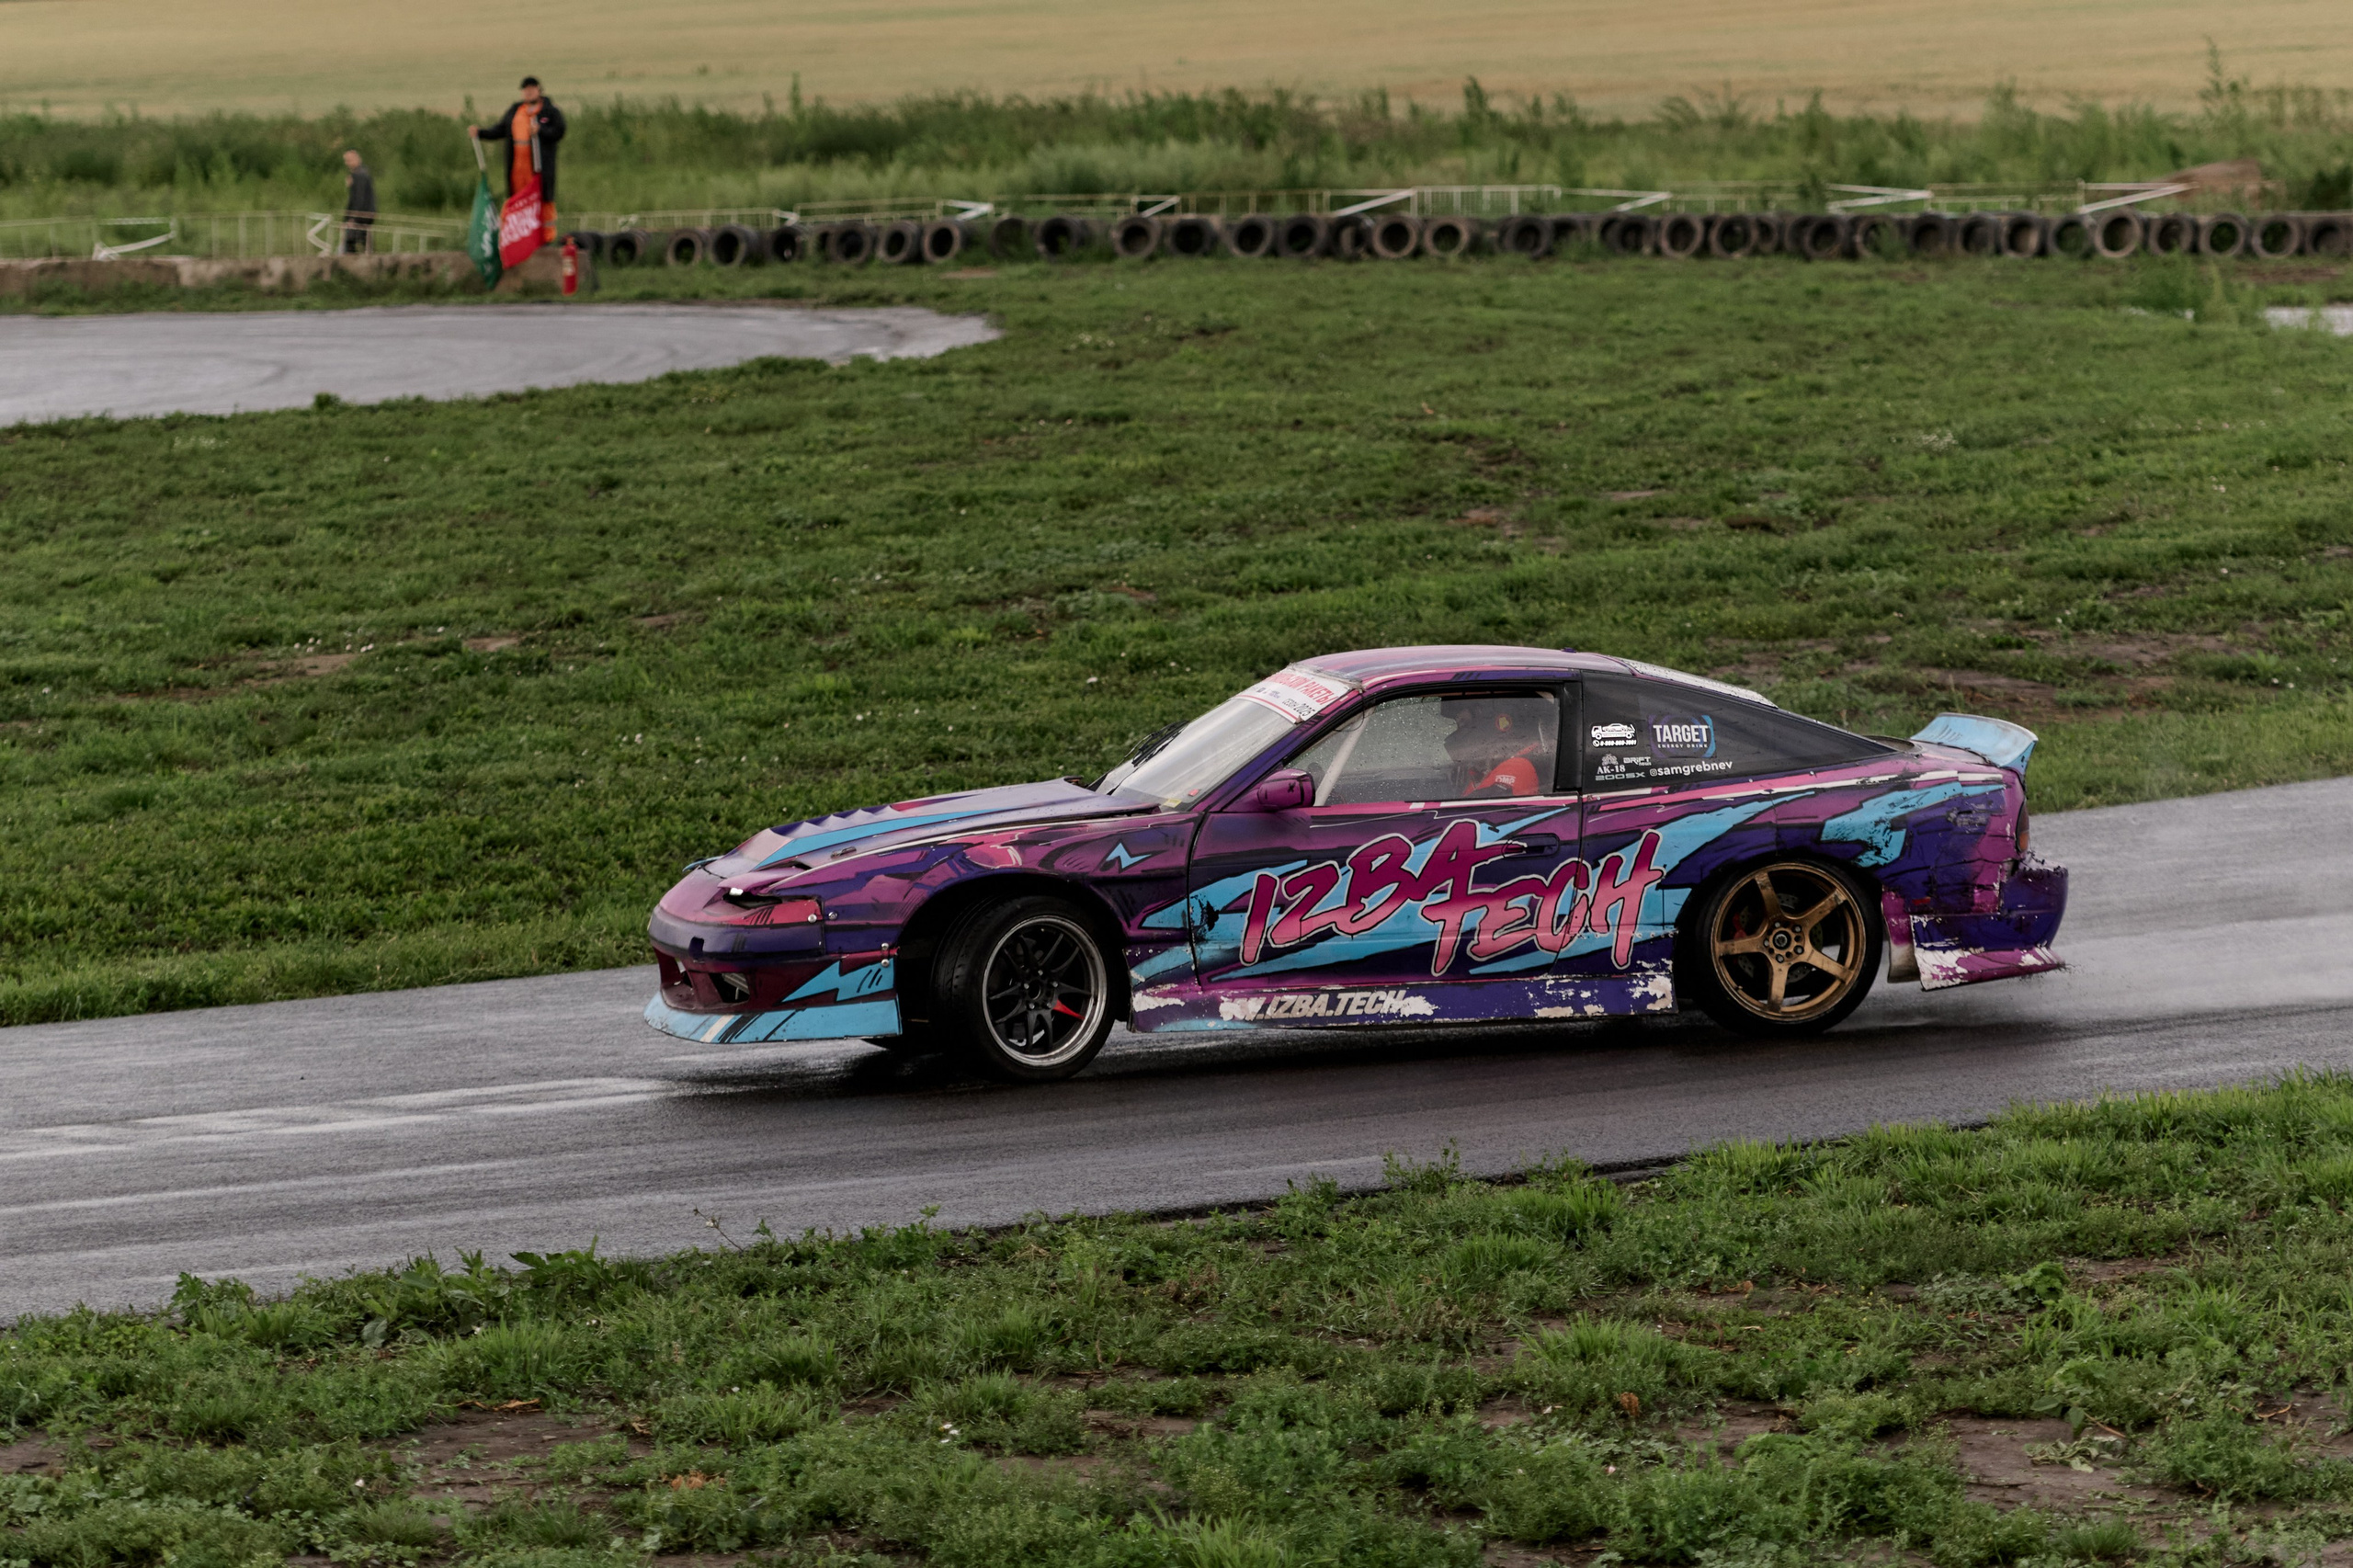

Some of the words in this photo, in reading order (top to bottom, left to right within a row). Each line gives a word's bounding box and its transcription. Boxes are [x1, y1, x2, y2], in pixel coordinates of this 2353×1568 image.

[1293, 703, 1315, 717] 2025
[1653, 724, 1710, 743] TARGET
[1595, 772, 1645, 781] 200SX
[1597, 765, 1626, 774] AK-18
[1495, 775, 1516, 785] OMP
[1421, 830, 1666, 976] TECH
[1220, 990, 1406, 1021] W.IZBA.TECH
